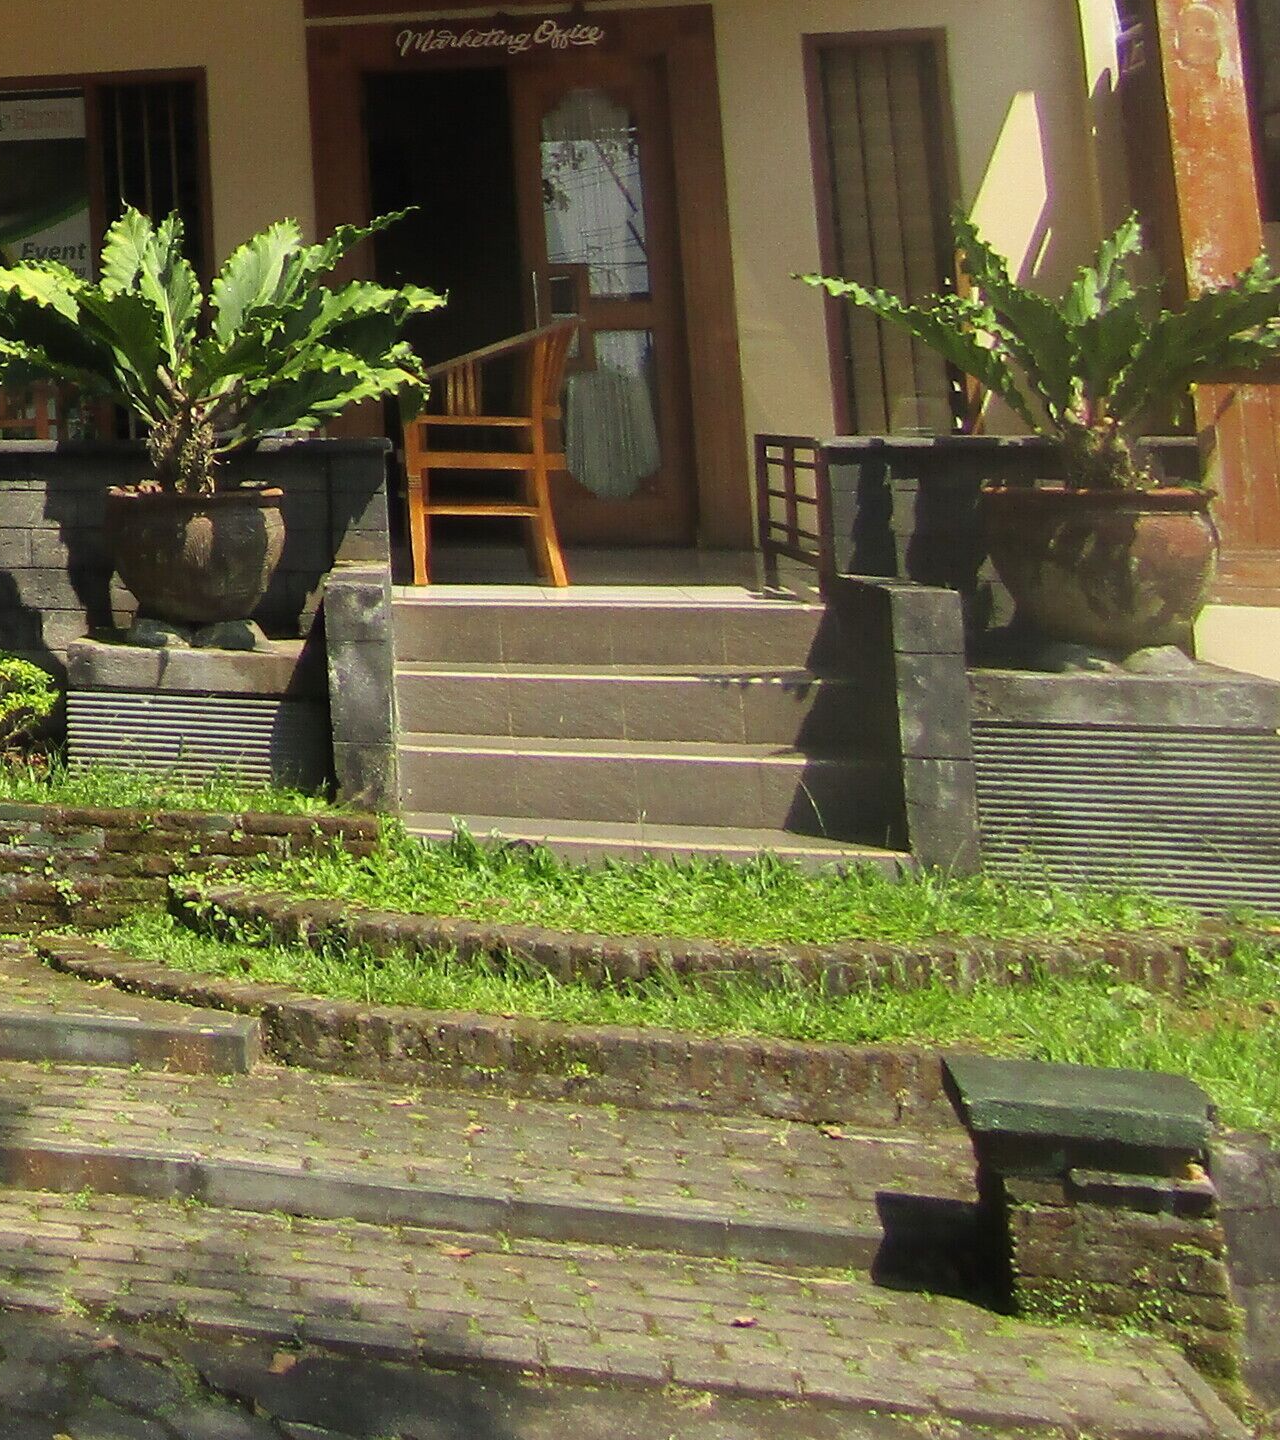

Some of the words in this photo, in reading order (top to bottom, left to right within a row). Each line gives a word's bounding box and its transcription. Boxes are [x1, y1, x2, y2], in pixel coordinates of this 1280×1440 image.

[395, 29, 532, 56] Marketing
[534, 20, 605, 48] Office
[22, 242, 87, 260] Event
